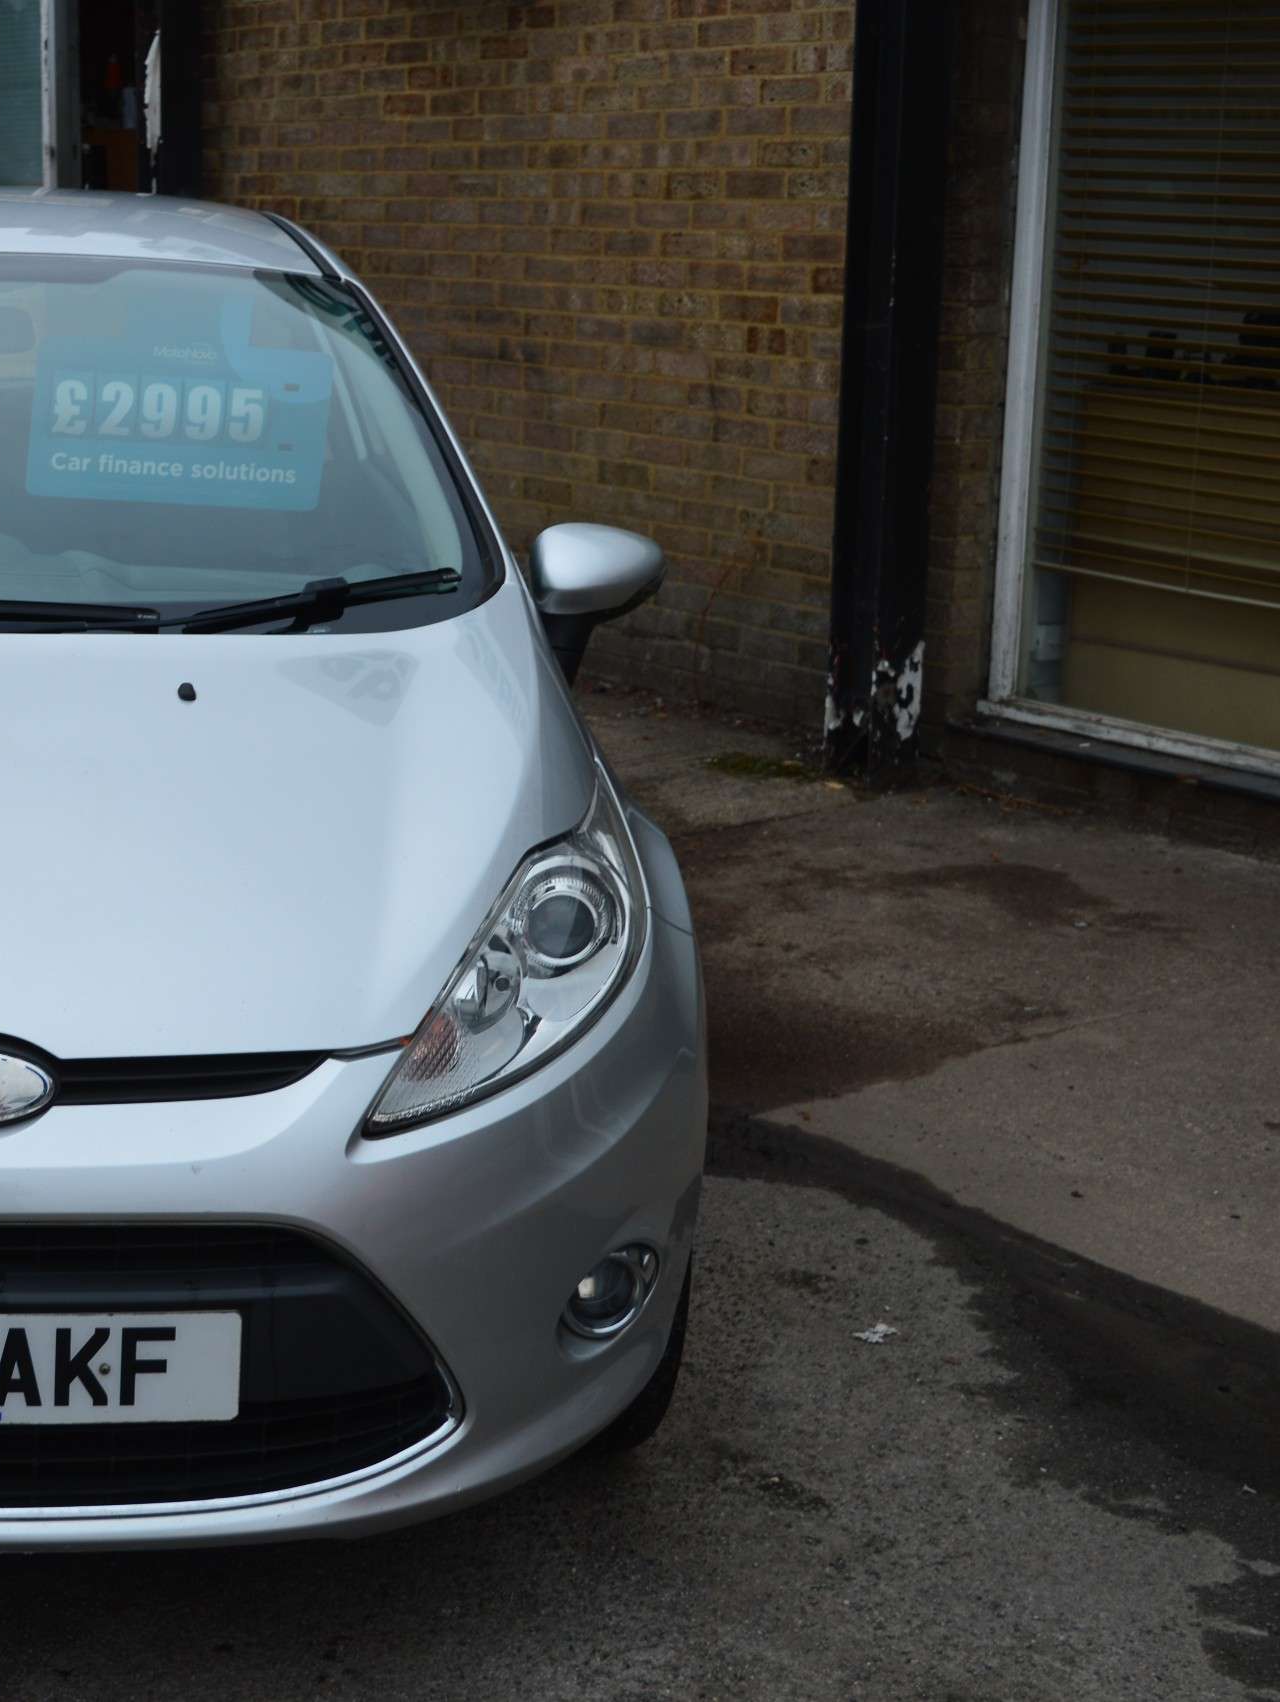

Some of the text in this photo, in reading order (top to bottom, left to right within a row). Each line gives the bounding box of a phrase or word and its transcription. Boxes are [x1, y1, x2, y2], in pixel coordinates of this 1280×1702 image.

[51, 379, 264, 442] £2995
[51, 452, 297, 485] Car finance solutions
